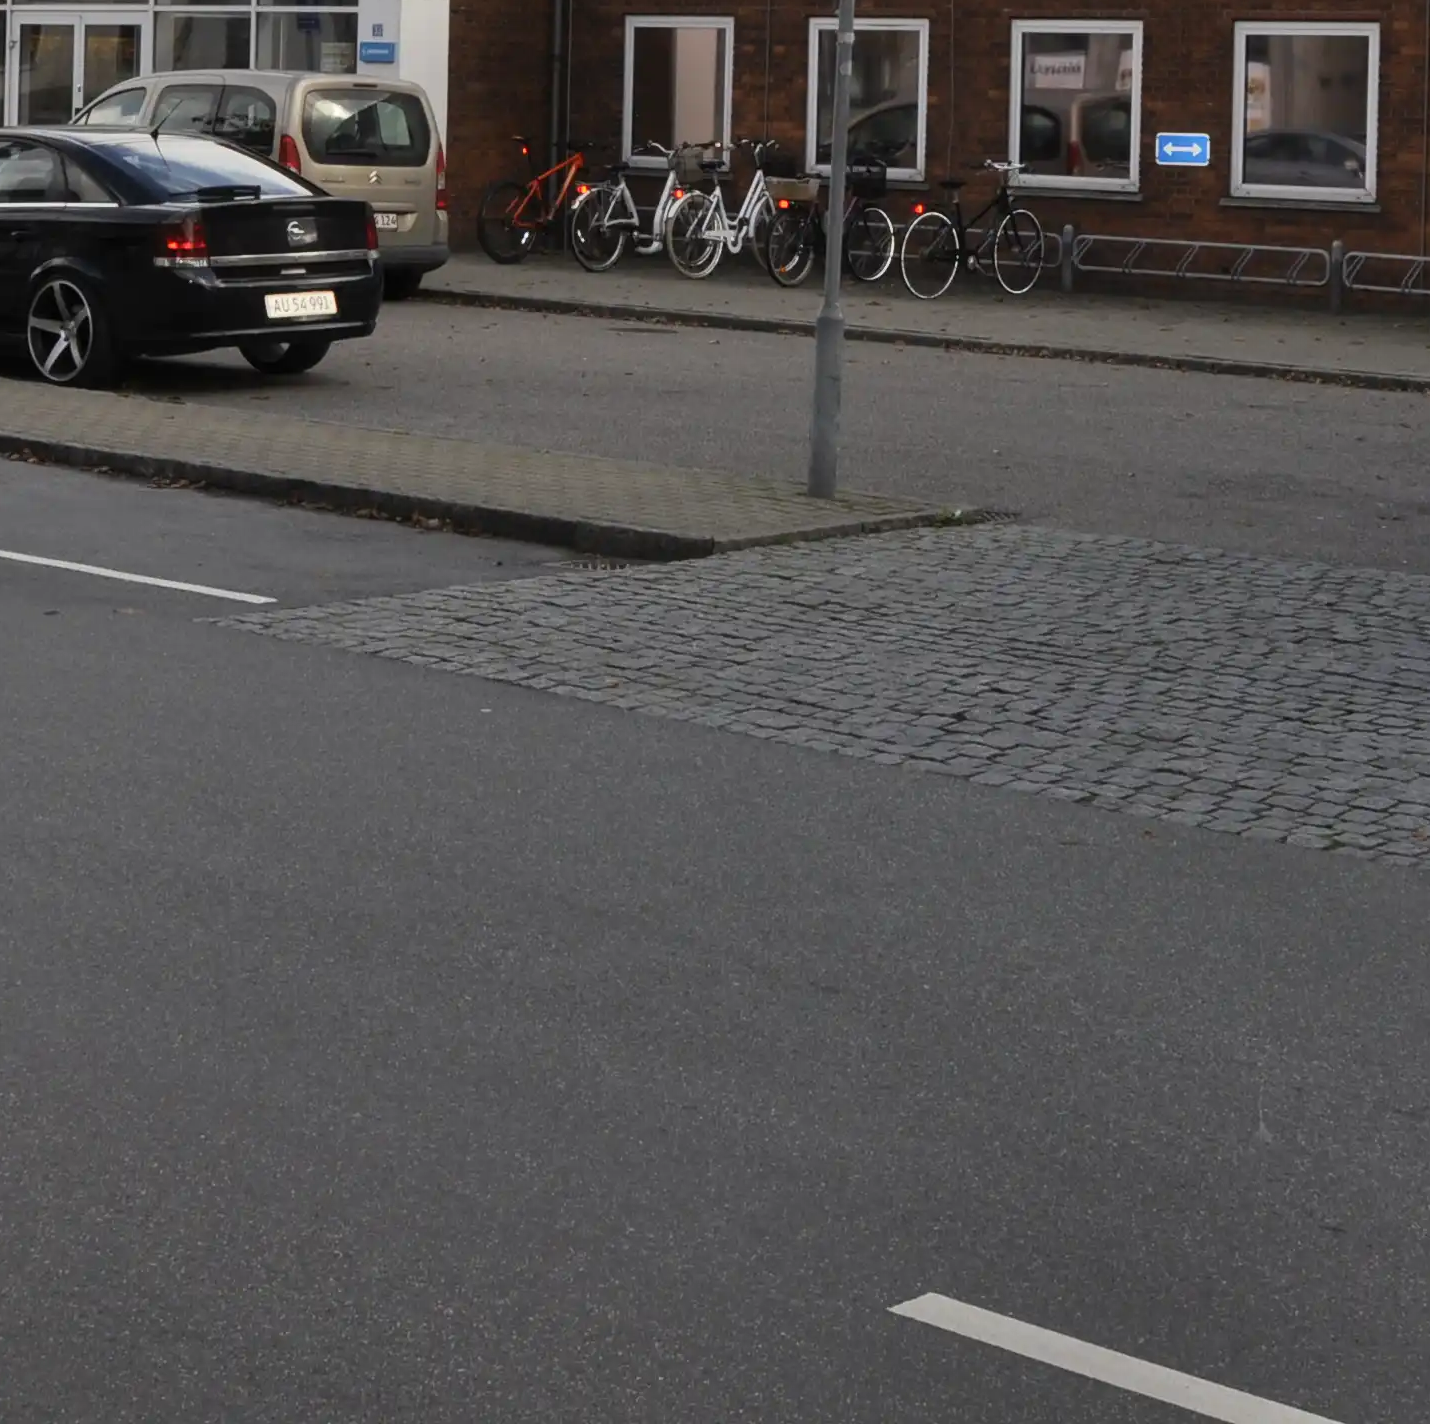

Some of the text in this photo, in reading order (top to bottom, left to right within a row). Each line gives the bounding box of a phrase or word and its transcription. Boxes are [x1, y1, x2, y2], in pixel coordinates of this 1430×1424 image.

[381, 215, 397, 226] 124
[274, 295, 331, 313] AU 54 991
